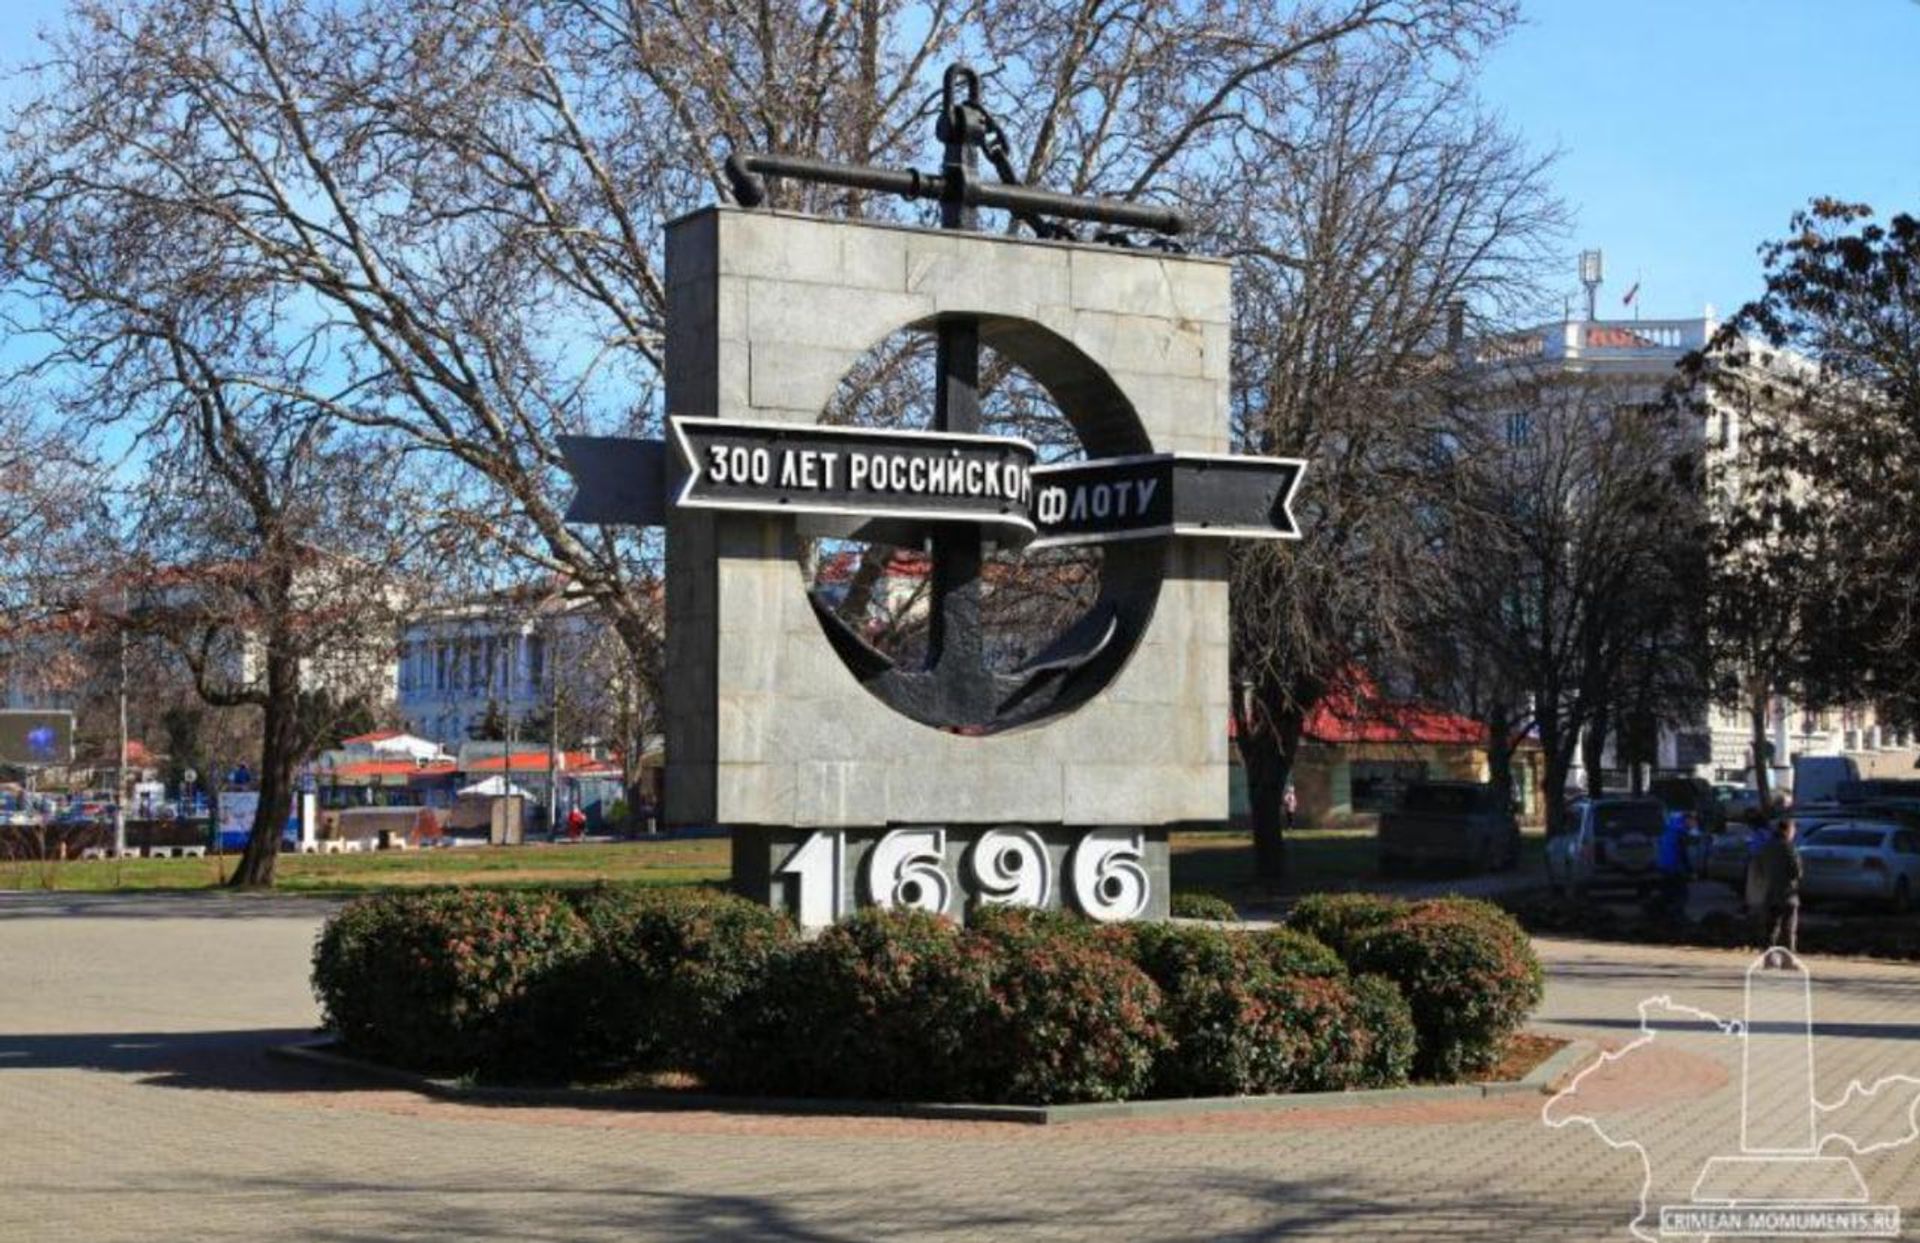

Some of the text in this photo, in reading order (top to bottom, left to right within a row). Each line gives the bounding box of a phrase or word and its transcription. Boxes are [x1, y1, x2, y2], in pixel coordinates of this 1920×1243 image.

[710, 445, 770, 484] 300
[780, 449, 838, 488] ЛЕТ
[1037, 478, 1158, 525] ФЛОТУ
[782, 828, 1150, 936] 1696
